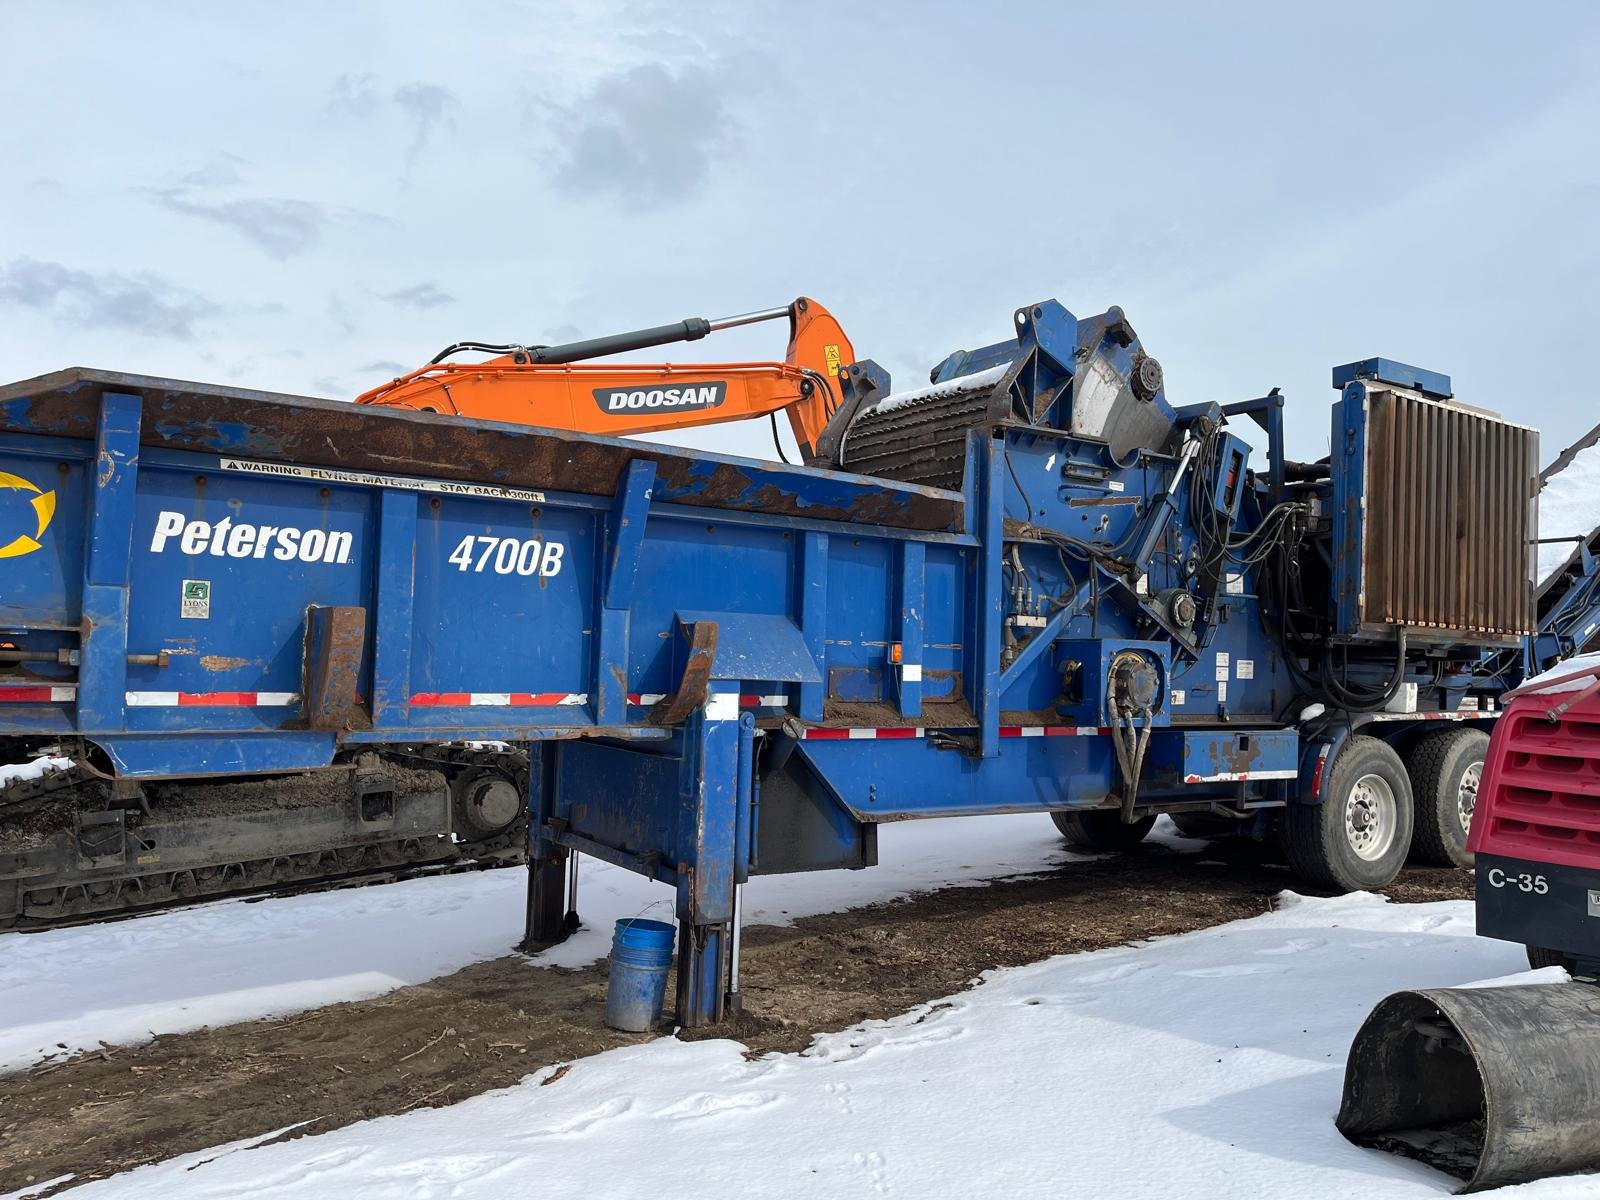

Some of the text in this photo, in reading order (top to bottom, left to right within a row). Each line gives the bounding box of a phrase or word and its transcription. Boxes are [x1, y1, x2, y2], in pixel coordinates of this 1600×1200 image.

[608, 386, 717, 410] DOOSAN
[240, 461, 301, 475] WARNING
[310, 470, 358, 482] FLYING
[440, 483, 470, 493] STAY
[511, 490, 542, 501] 300ft.
[150, 511, 353, 564] Peterson
[448, 535, 565, 577] 4700B
[1488, 868, 1549, 895] C-35
